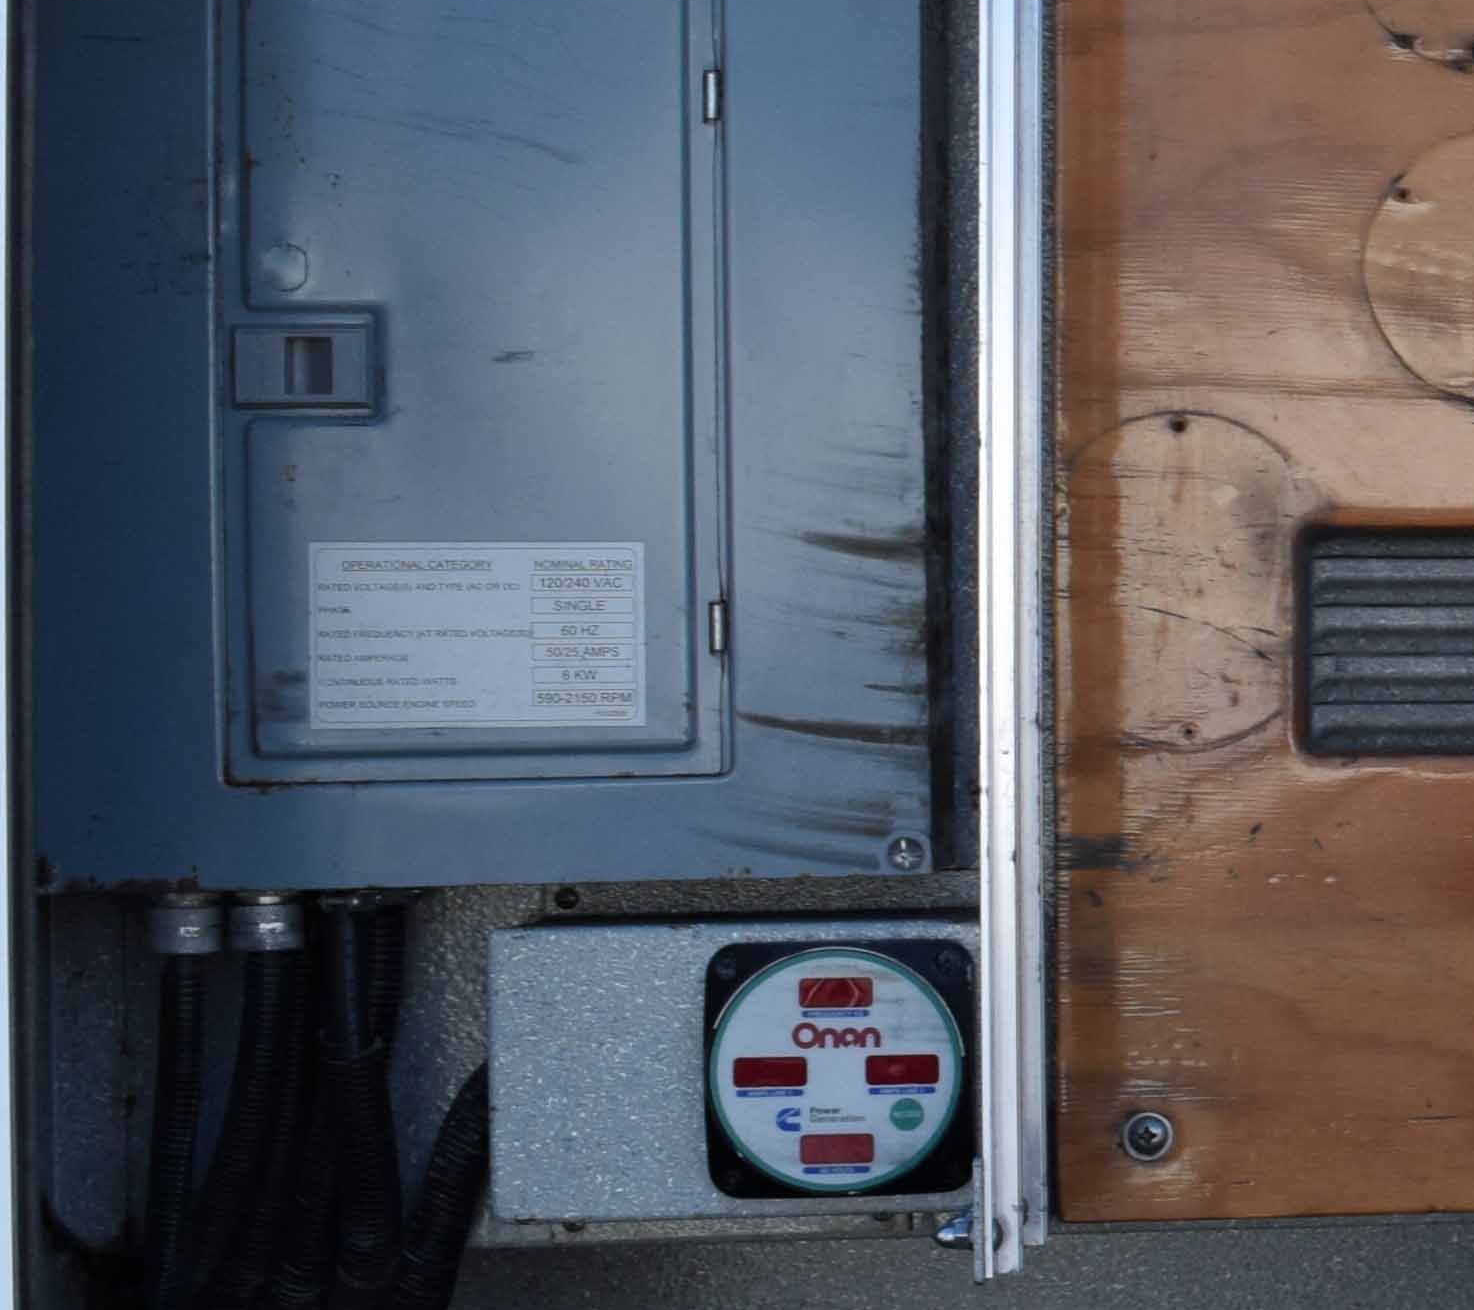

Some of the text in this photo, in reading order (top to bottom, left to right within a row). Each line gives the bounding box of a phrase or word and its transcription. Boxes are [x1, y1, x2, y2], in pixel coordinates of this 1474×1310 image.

[341, 560, 493, 572] OPERATIONAL CATEGORY
[533, 559, 633, 571] NOMINAL RATING
[540, 576, 622, 589] 120/240 VAC
[553, 599, 606, 611] SINGLE
[580, 624, 600, 636] HZ
[581, 646, 620, 658] AMPS
[574, 670, 598, 681] KW
[600, 692, 633, 704] RPM
[792, 1022, 882, 1050] Onan
